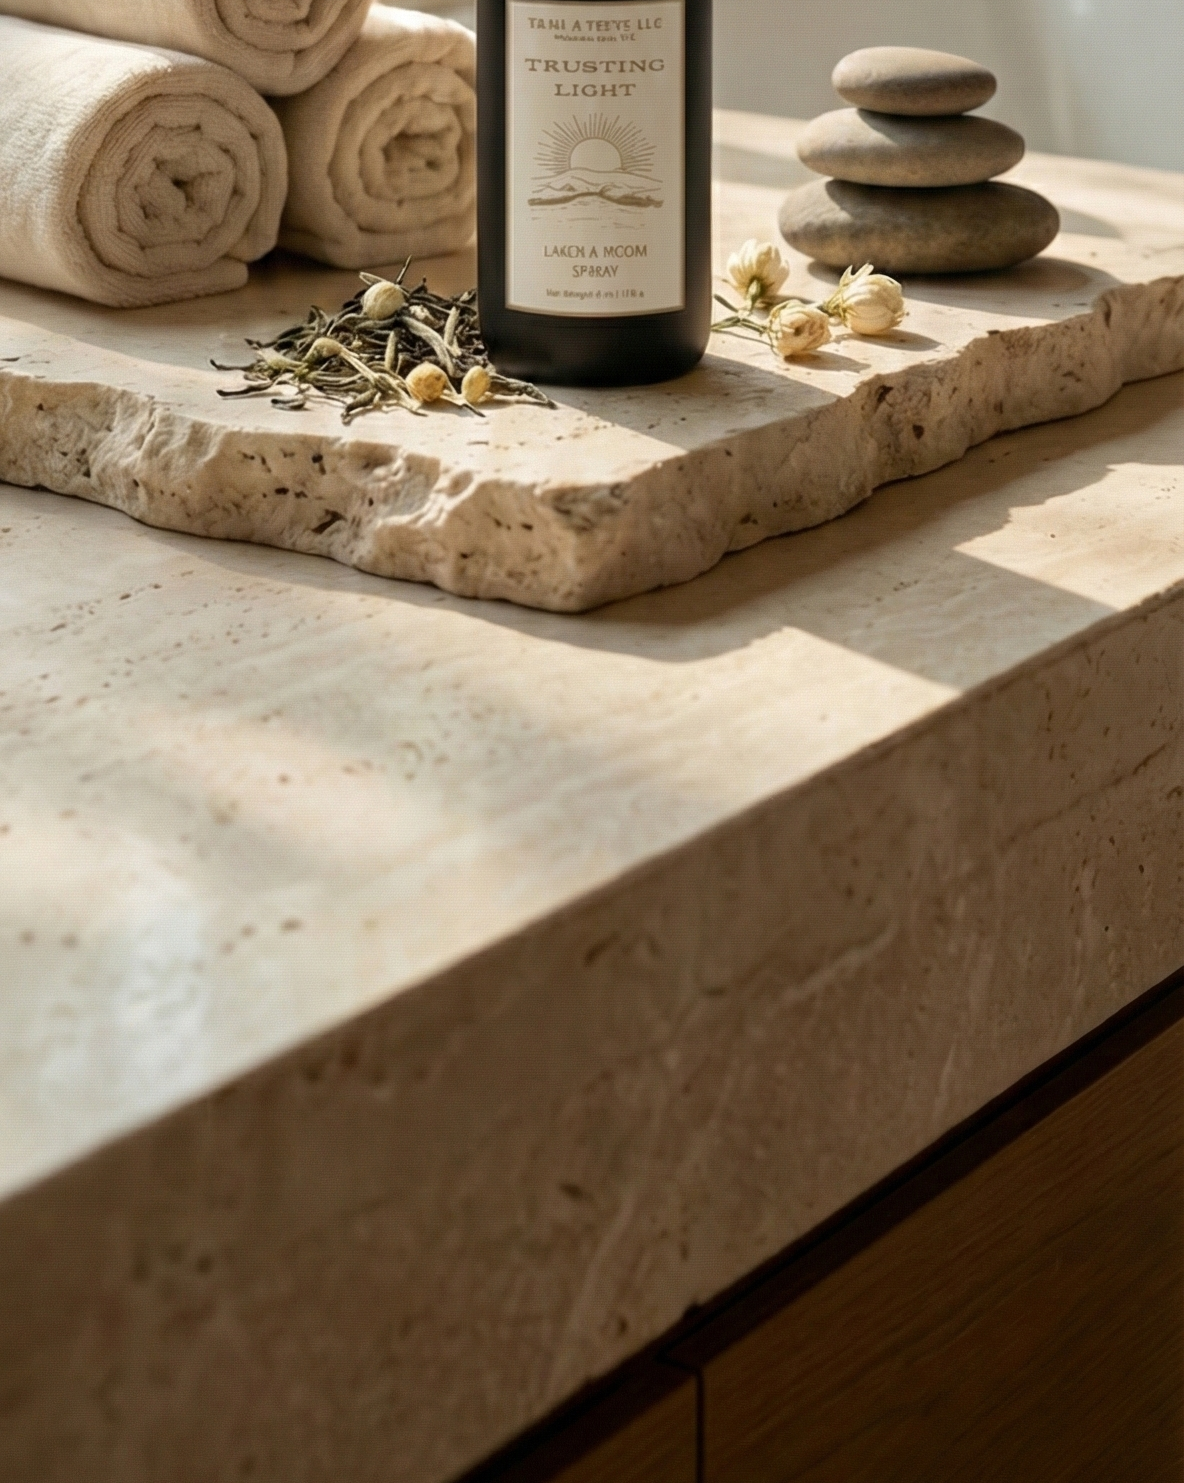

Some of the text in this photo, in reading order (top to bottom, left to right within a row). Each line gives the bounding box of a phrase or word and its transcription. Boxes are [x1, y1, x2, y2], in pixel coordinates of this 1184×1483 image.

[572, 19, 582, 31] A
[637, 18, 662, 30] LLC
[525, 58, 665, 73] TRUSTING
[554, 83, 636, 97] LIGHT
[588, 245, 599, 258] A
